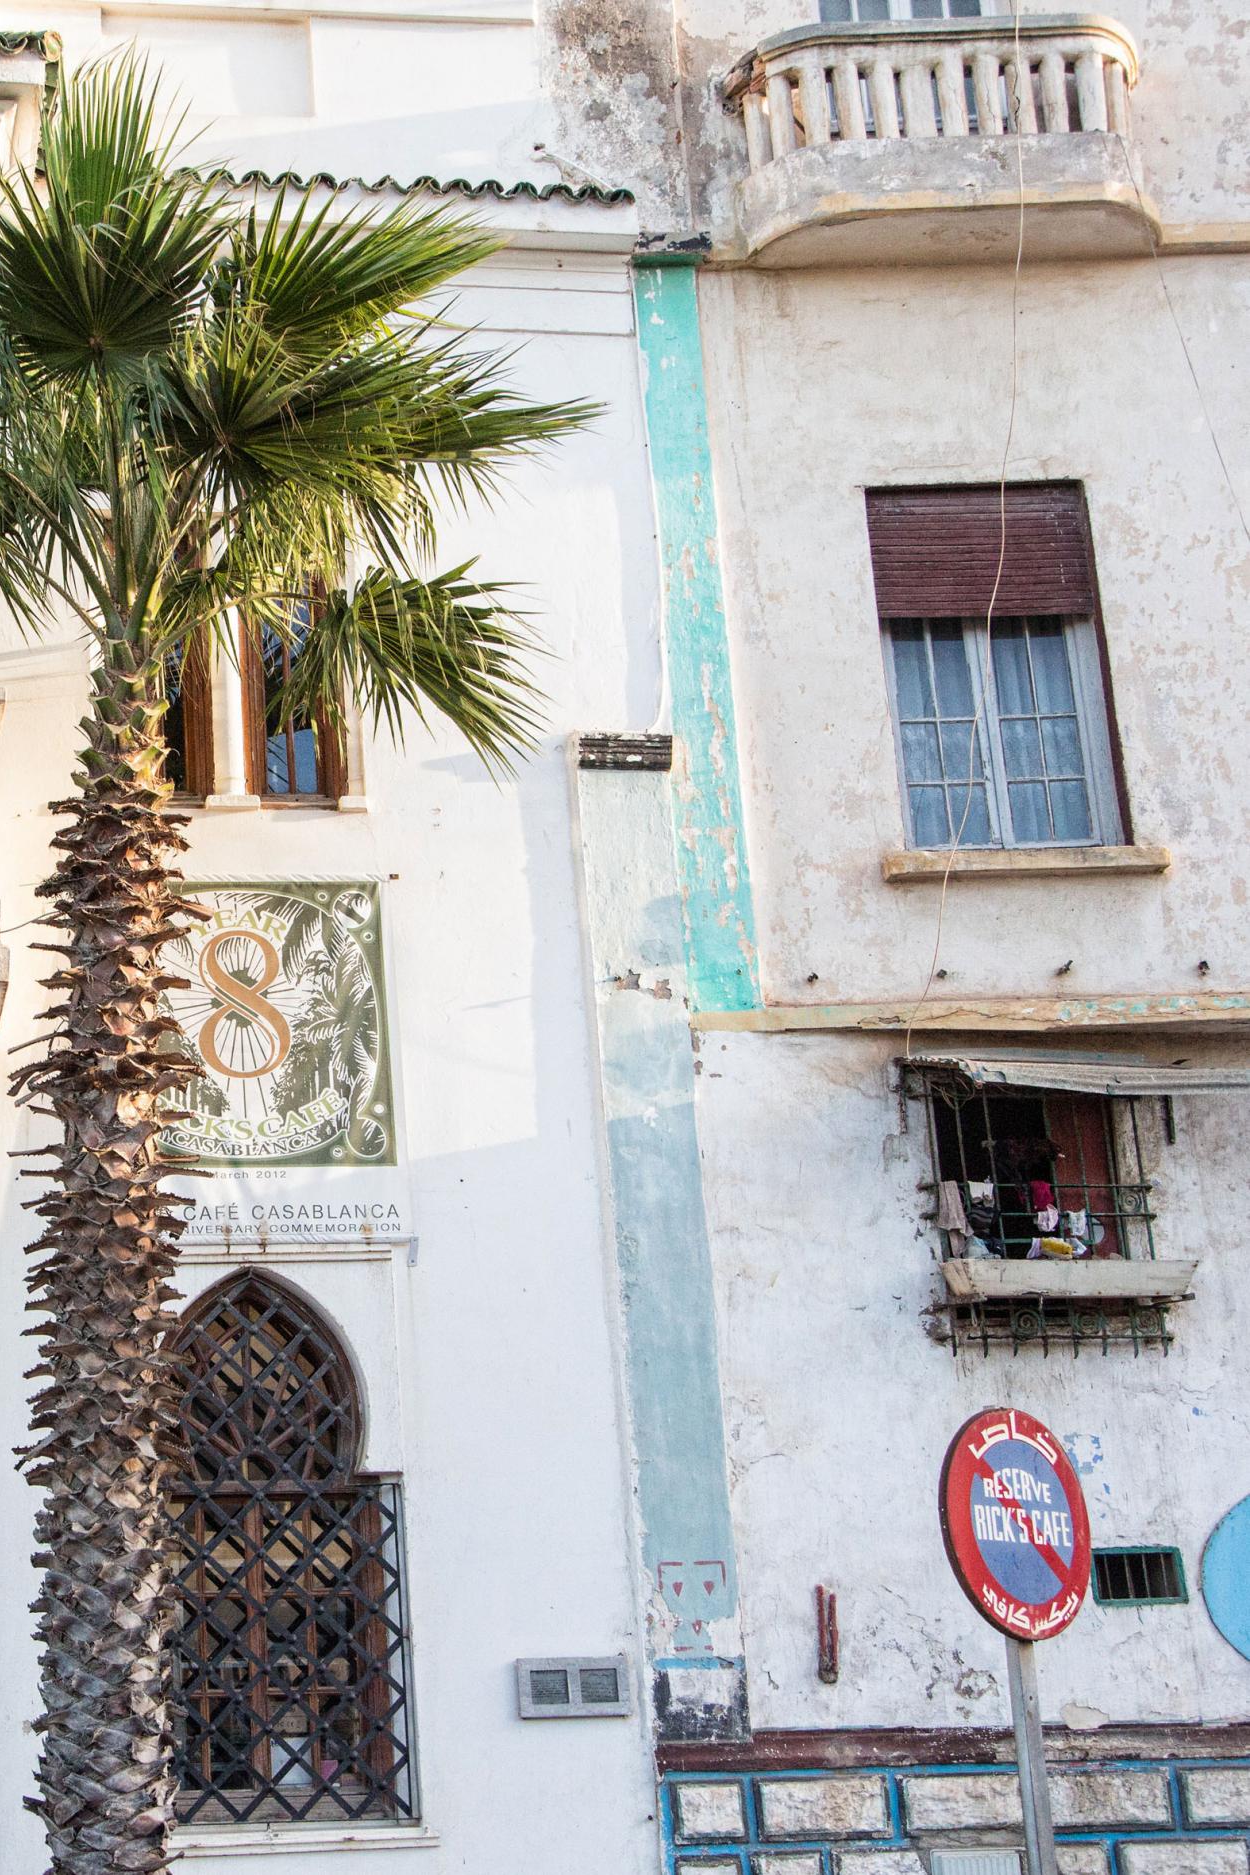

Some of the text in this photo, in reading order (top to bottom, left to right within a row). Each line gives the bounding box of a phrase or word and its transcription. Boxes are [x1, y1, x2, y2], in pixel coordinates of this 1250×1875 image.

[199, 930, 291, 1079] 8
[158, 1097, 253, 1140] CK'S
[171, 1131, 322, 1156] CASABLANCA
[256, 1170, 287, 1179] 2012
[183, 1203, 400, 1221] CAFÉ CASABLANCA
[983, 1467, 1052, 1504] RESERVE
[974, 1504, 1072, 1547] RICK'S CAFE
